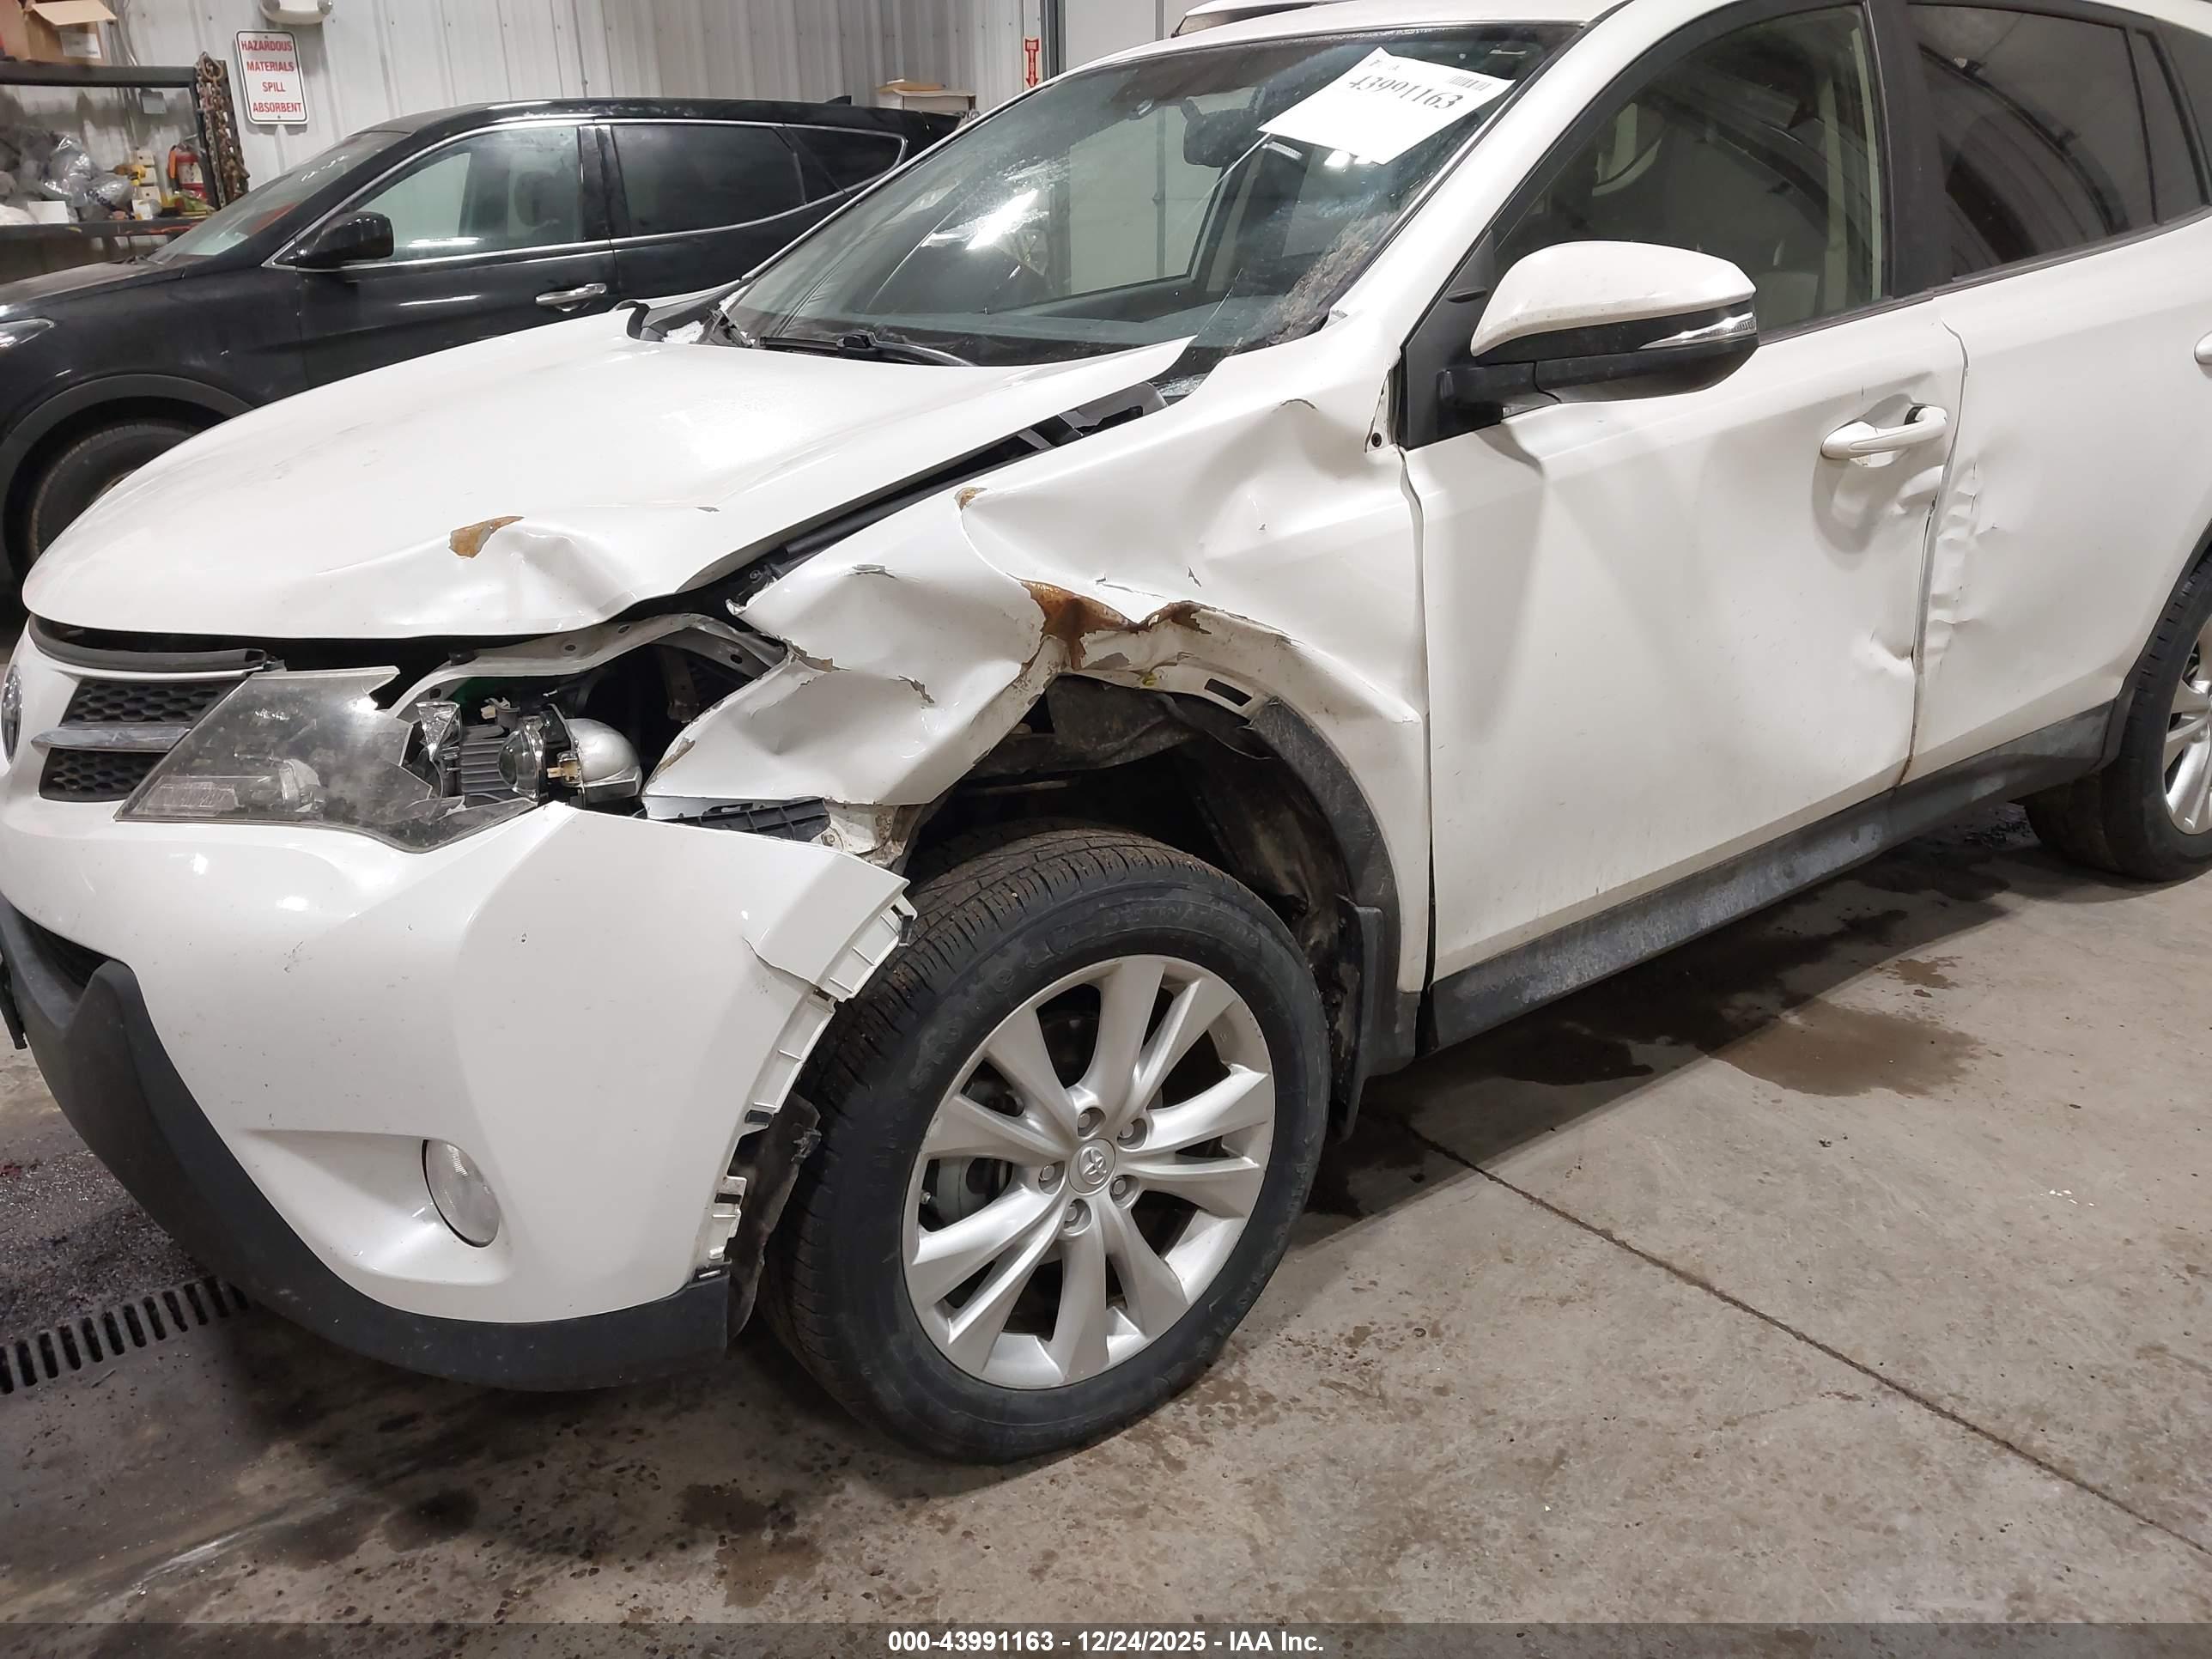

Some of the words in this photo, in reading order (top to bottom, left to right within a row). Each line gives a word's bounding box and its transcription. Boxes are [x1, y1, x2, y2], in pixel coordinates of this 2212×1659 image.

[241, 40, 293, 52] HAZARDOUS
[246, 61, 295, 71] MATERIALS
[262, 82, 286, 92] SPILL
[252, 102, 302, 112] ABSORBENT
